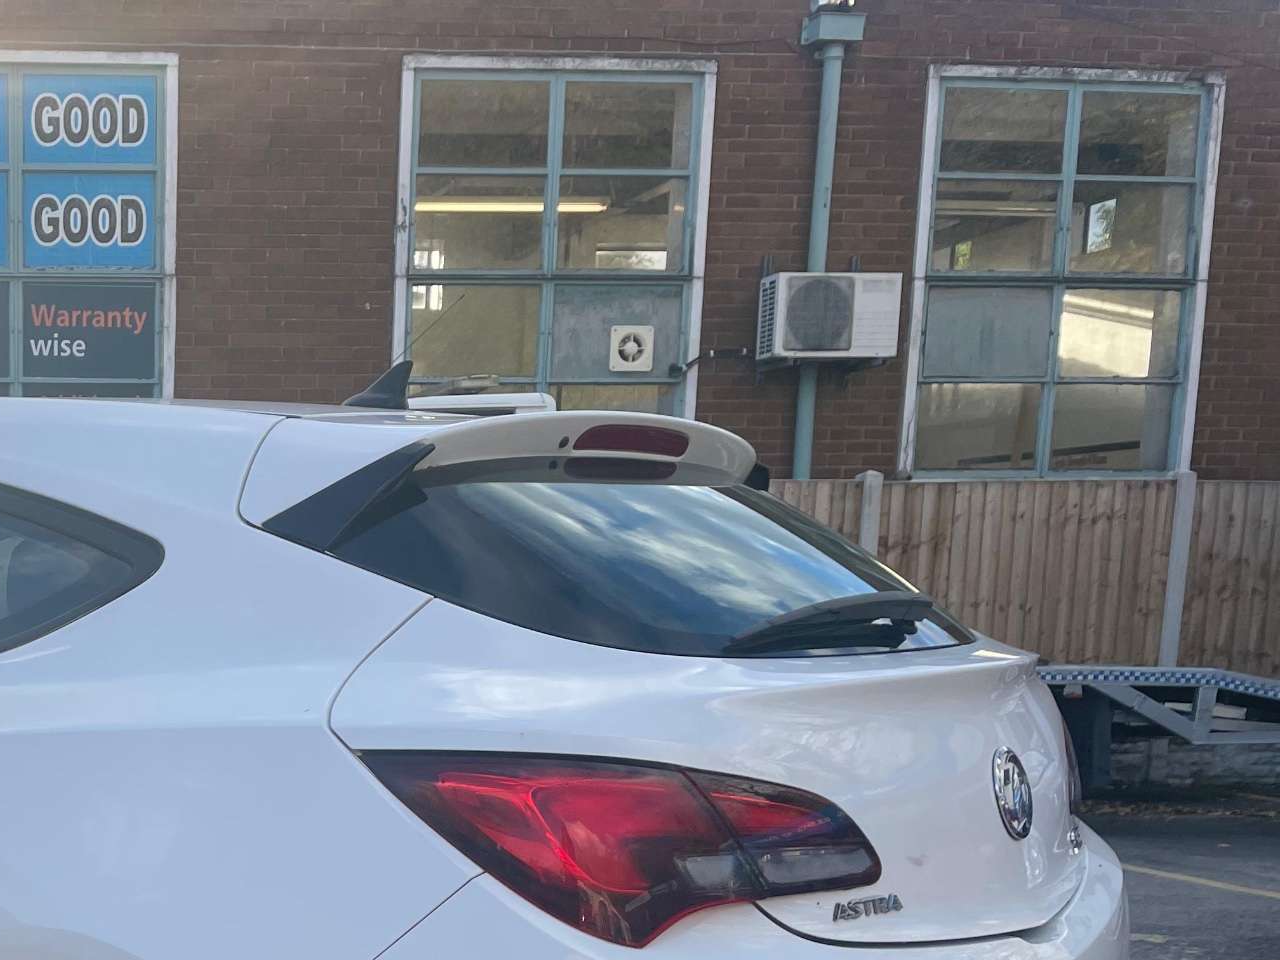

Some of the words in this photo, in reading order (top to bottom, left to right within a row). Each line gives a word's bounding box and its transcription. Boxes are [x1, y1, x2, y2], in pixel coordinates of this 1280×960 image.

[32, 93, 148, 147] GOOD
[31, 194, 146, 247] GOOD
[31, 304, 147, 333] Warranty
[30, 333, 87, 357] wise
[832, 893, 904, 923] ASTRA
